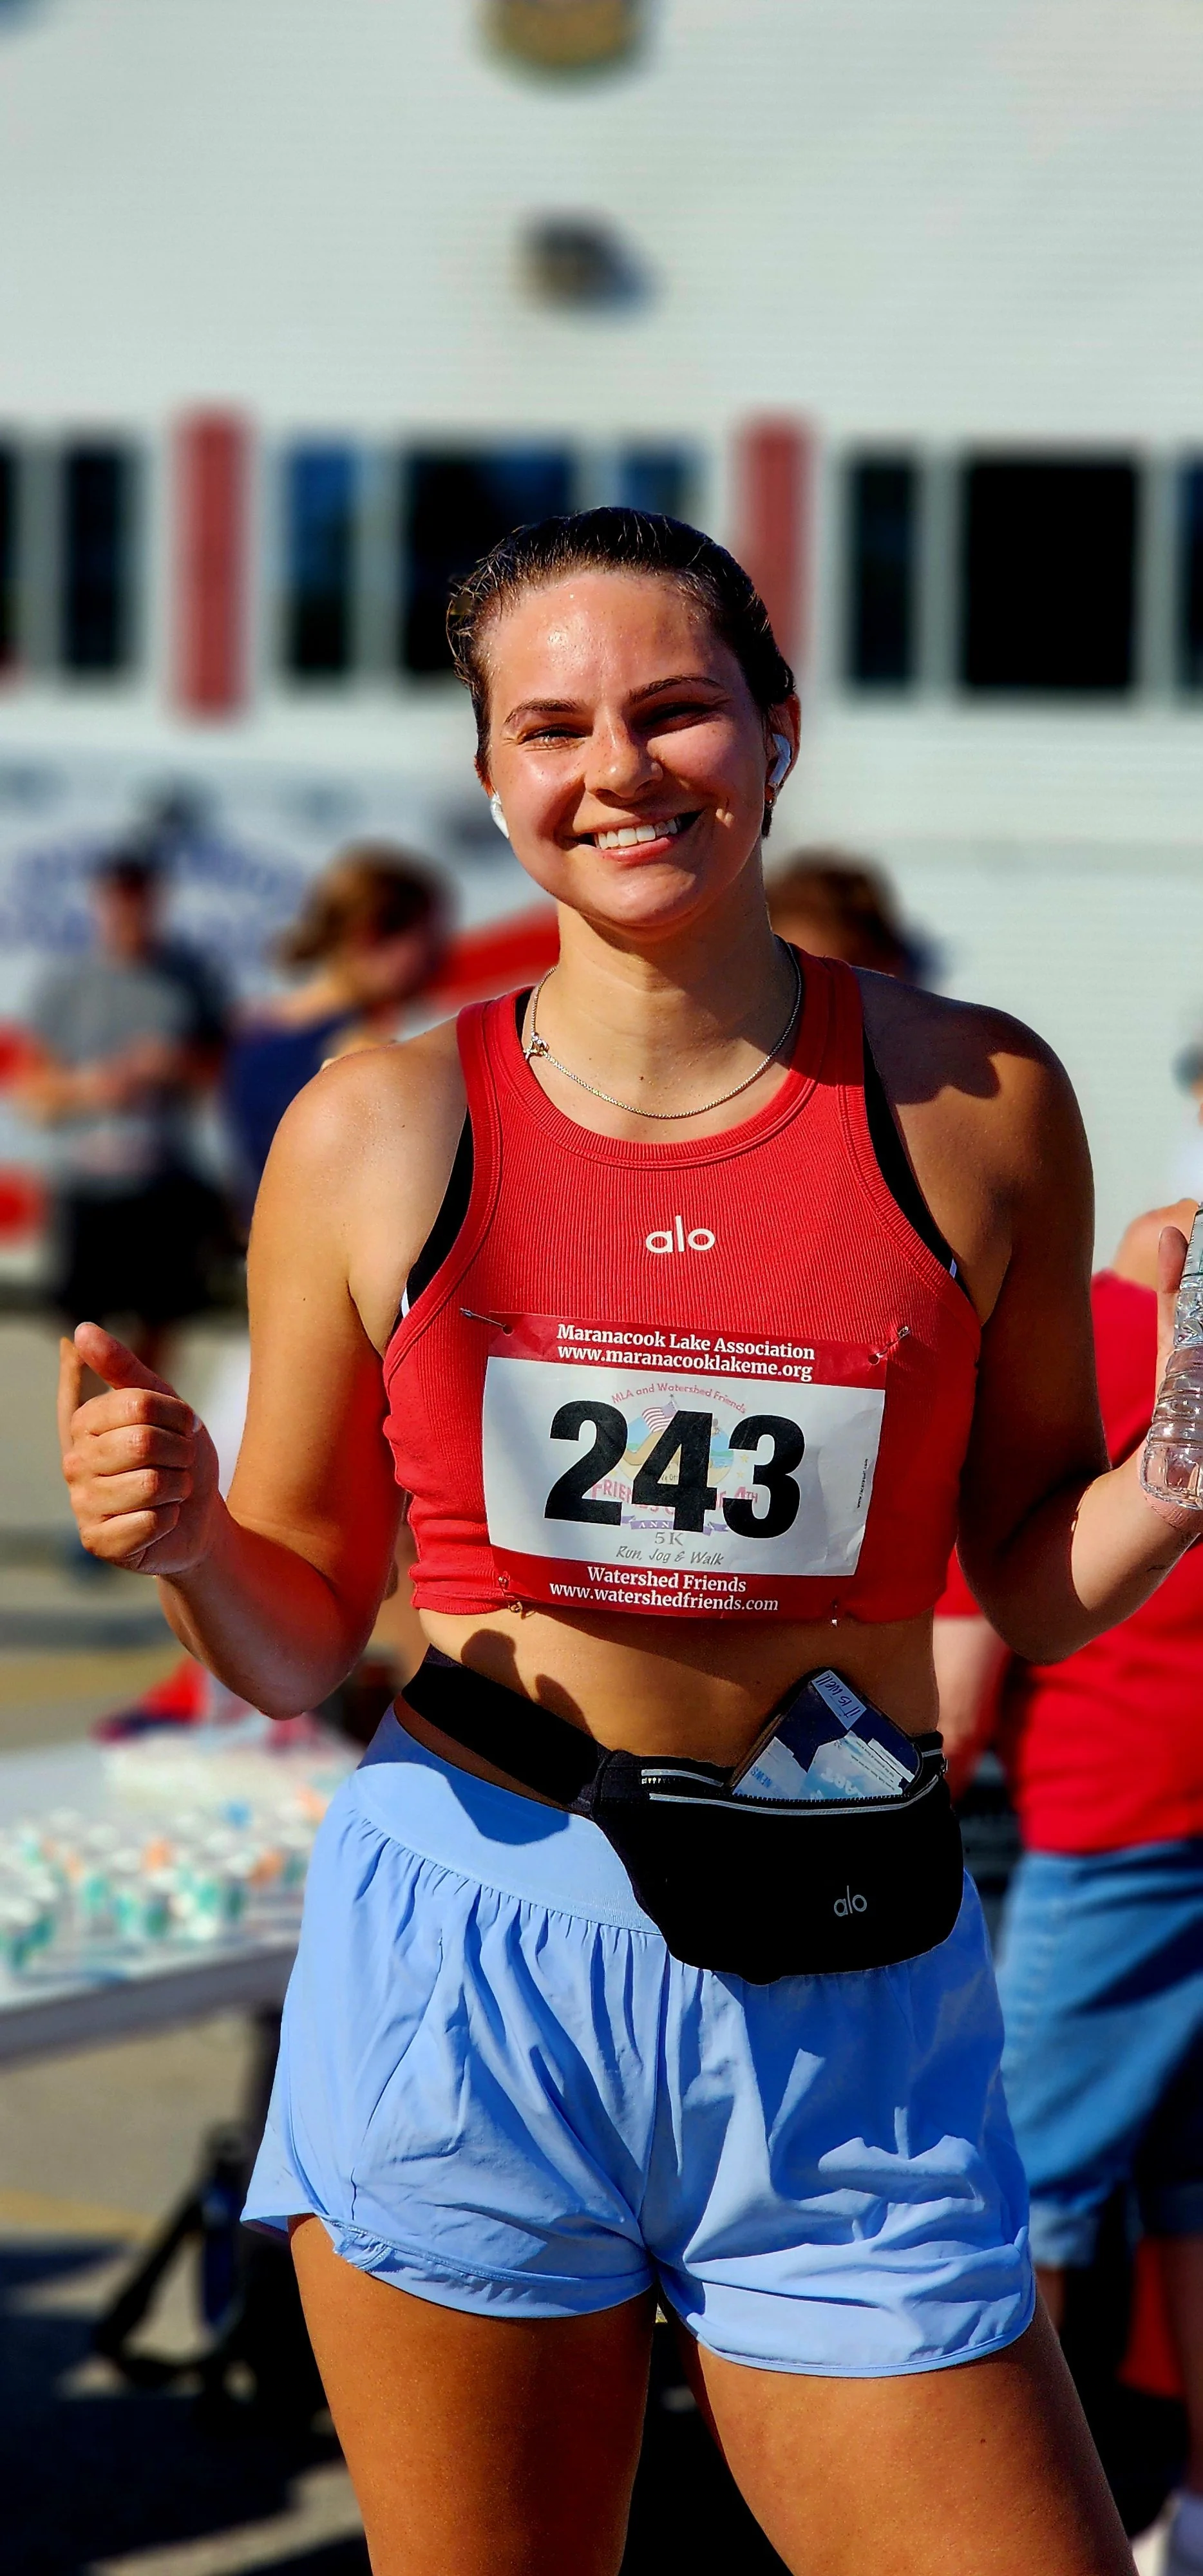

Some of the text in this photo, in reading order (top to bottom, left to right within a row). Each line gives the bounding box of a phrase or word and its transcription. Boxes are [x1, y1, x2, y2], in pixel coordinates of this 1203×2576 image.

[645, 1215, 715, 1253] alo
[556, 1323, 815, 1359] Maranacook Lake Association
[558, 1346, 813, 1382] www.maranacooklakeme.org
[612, 1383, 747, 1414] MLA and Watershed Friends
[545, 1400, 804, 1539] 243
[616, 1545, 725, 1566] Run, Jog & Walk
[587, 1566, 746, 1593] Watershed Friends
[549, 1583, 779, 1611] www.watershedfriends.com
[834, 1885, 867, 1917] alo
